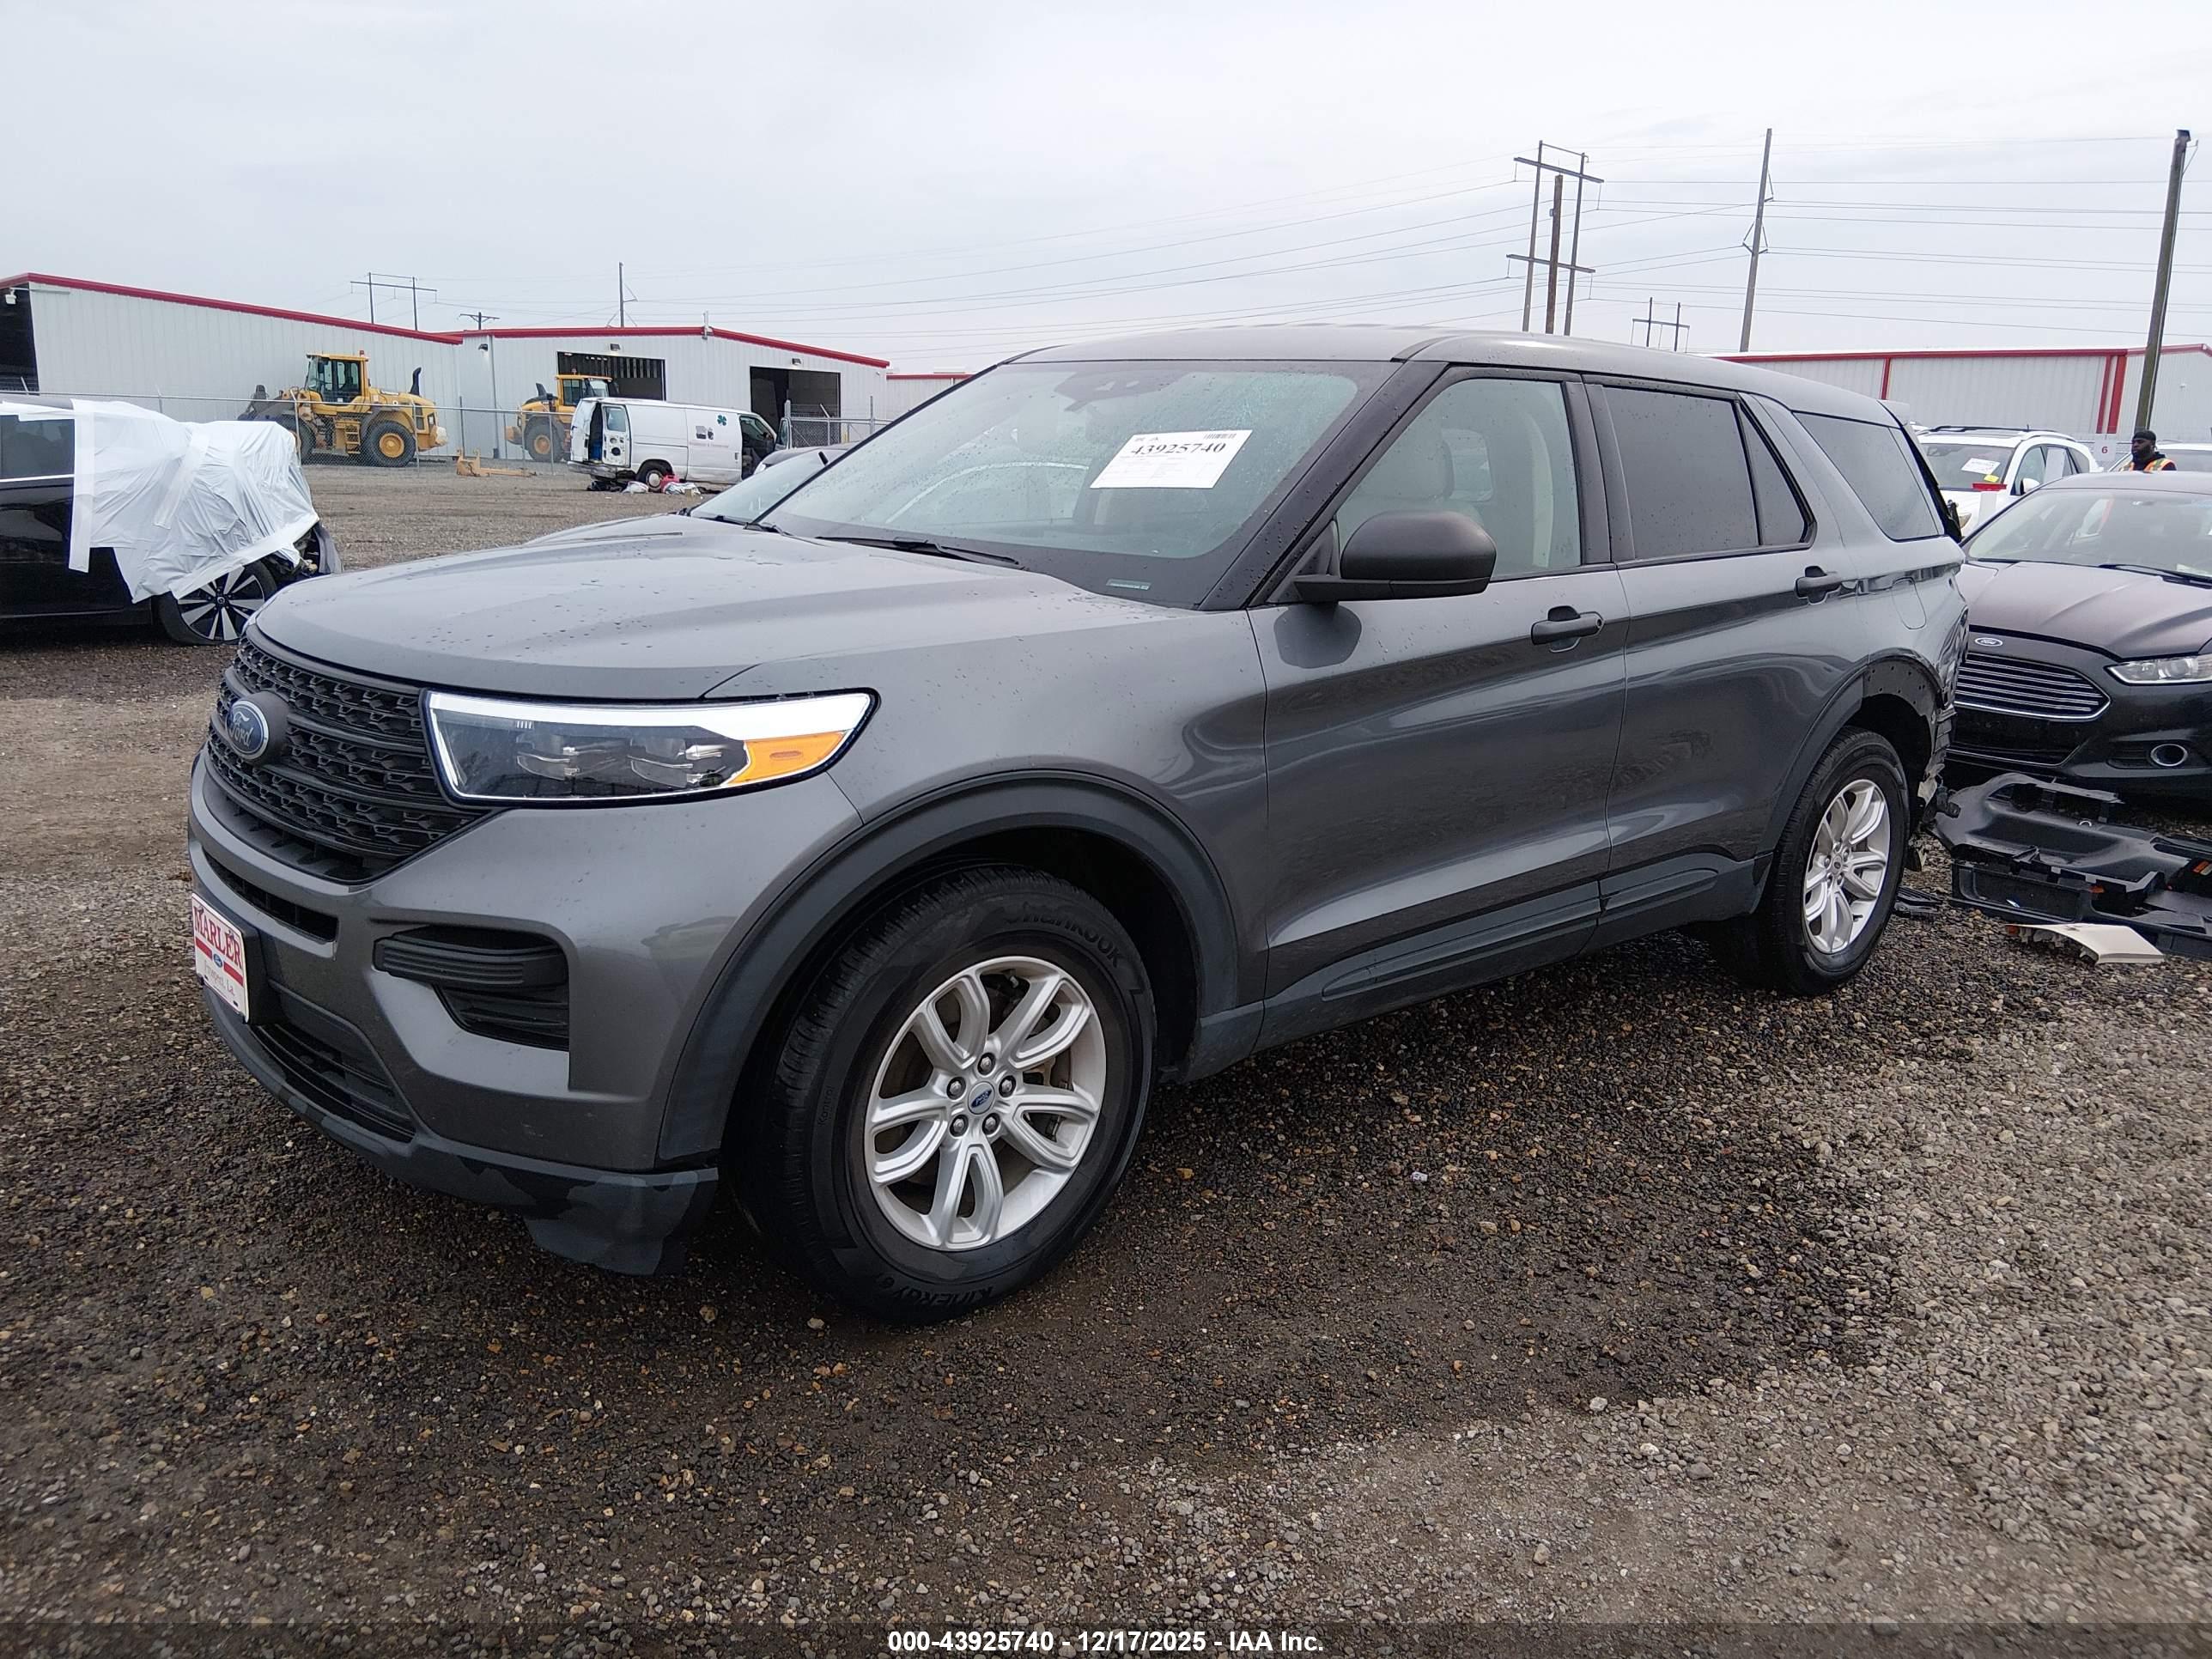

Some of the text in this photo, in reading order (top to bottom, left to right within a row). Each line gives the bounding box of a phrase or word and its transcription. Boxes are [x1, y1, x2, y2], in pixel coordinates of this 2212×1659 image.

[1131, 442, 1226, 455] 43925740
[2101, 446, 2108, 454] 6
[229, 711, 254, 749] Ford
[193, 905, 243, 969] MARLER
